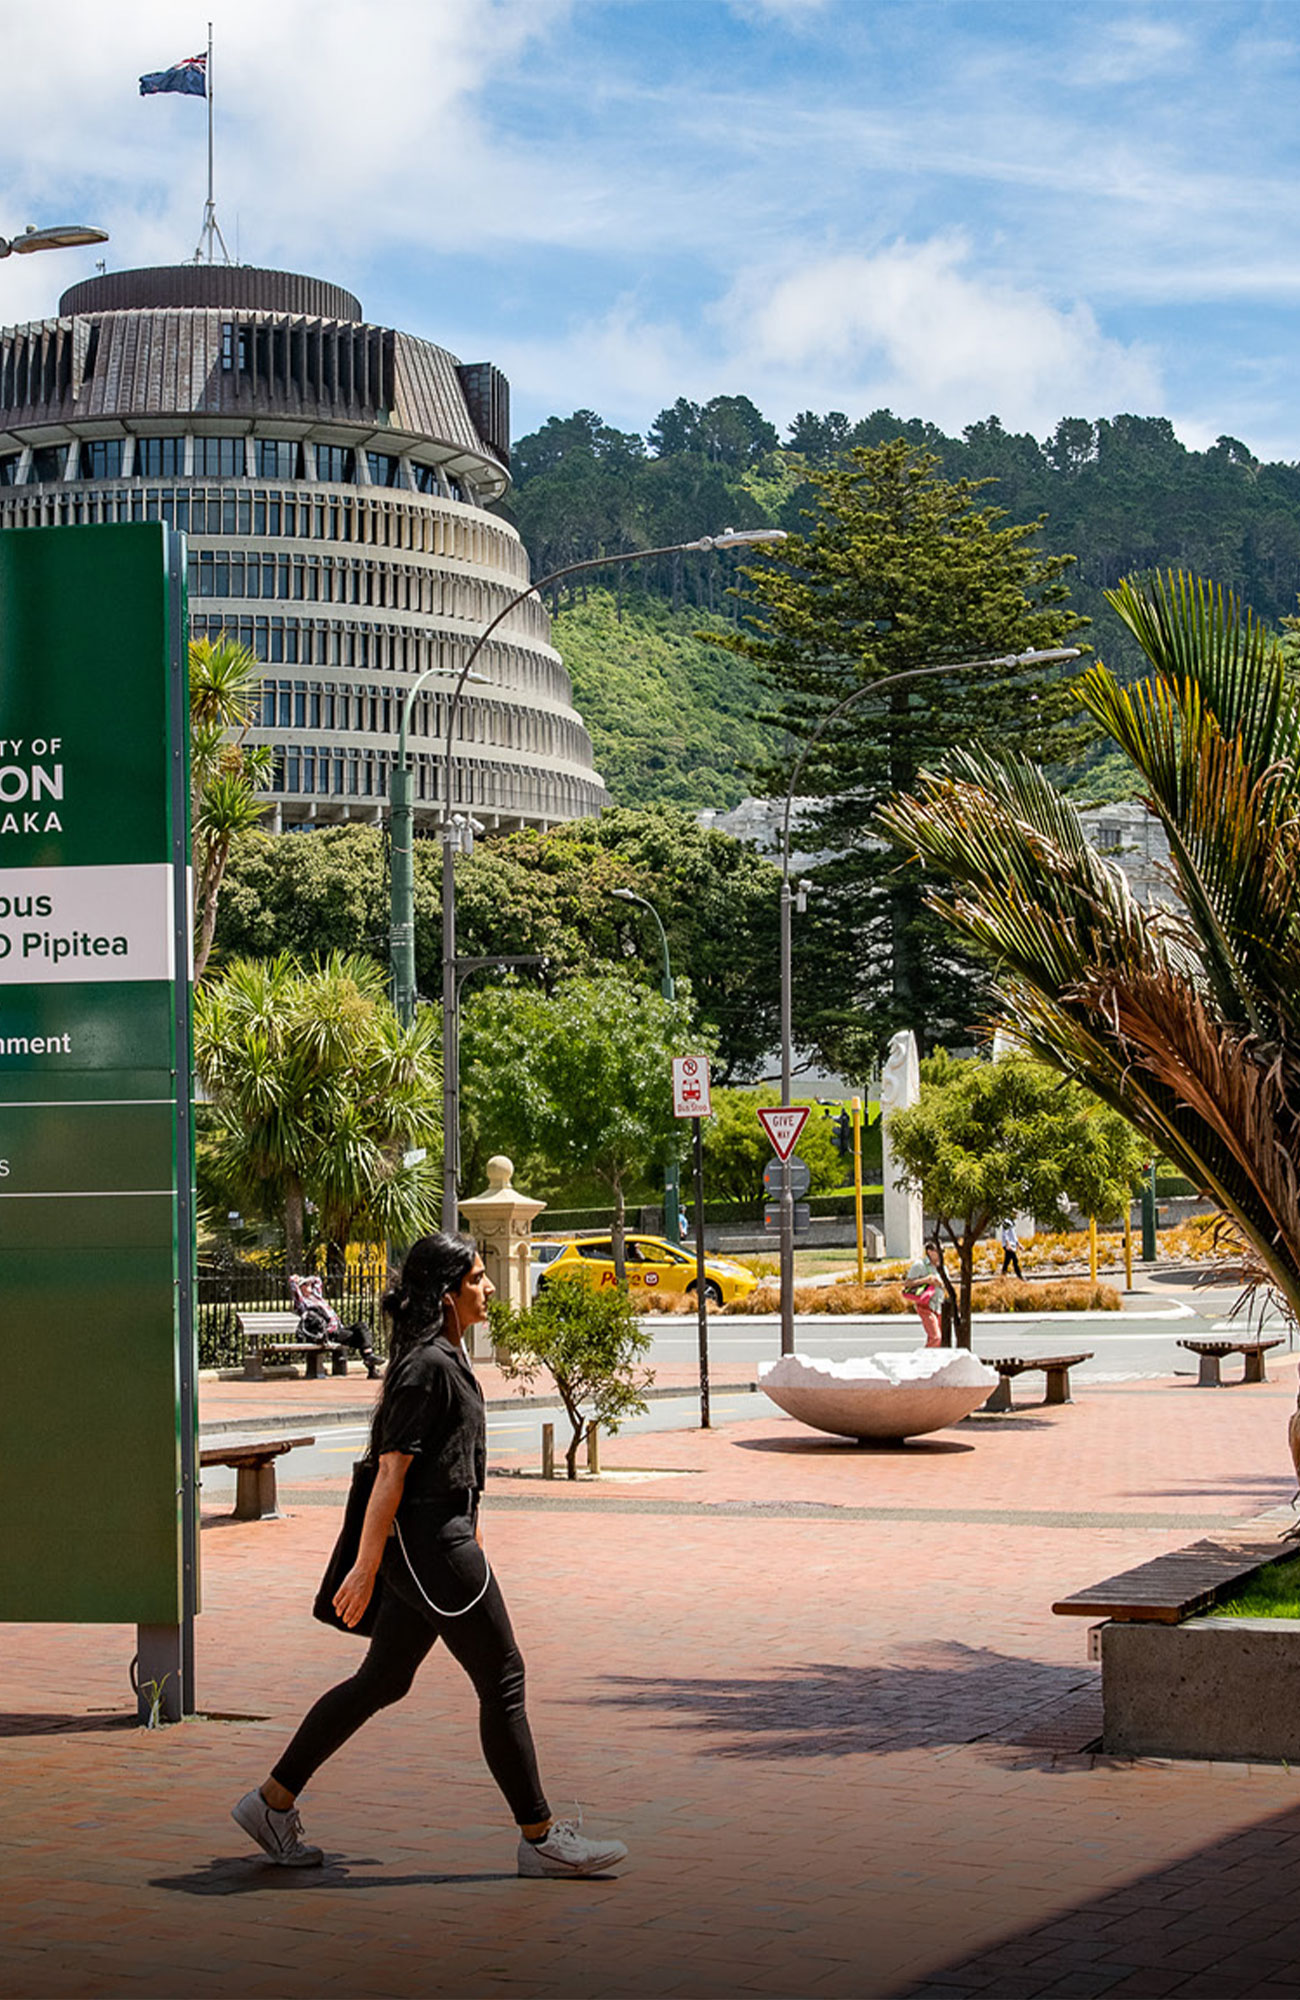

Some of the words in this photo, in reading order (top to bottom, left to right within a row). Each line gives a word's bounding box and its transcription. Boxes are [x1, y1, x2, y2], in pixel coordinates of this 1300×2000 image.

[31, 738, 62, 756] OF
[0, 764, 64, 803] ON
[1, 811, 63, 834] AKA
[23, 931, 128, 963] Pipitea
[772, 1115, 795, 1127] GIVE
[777, 1130, 790, 1139] WAY
